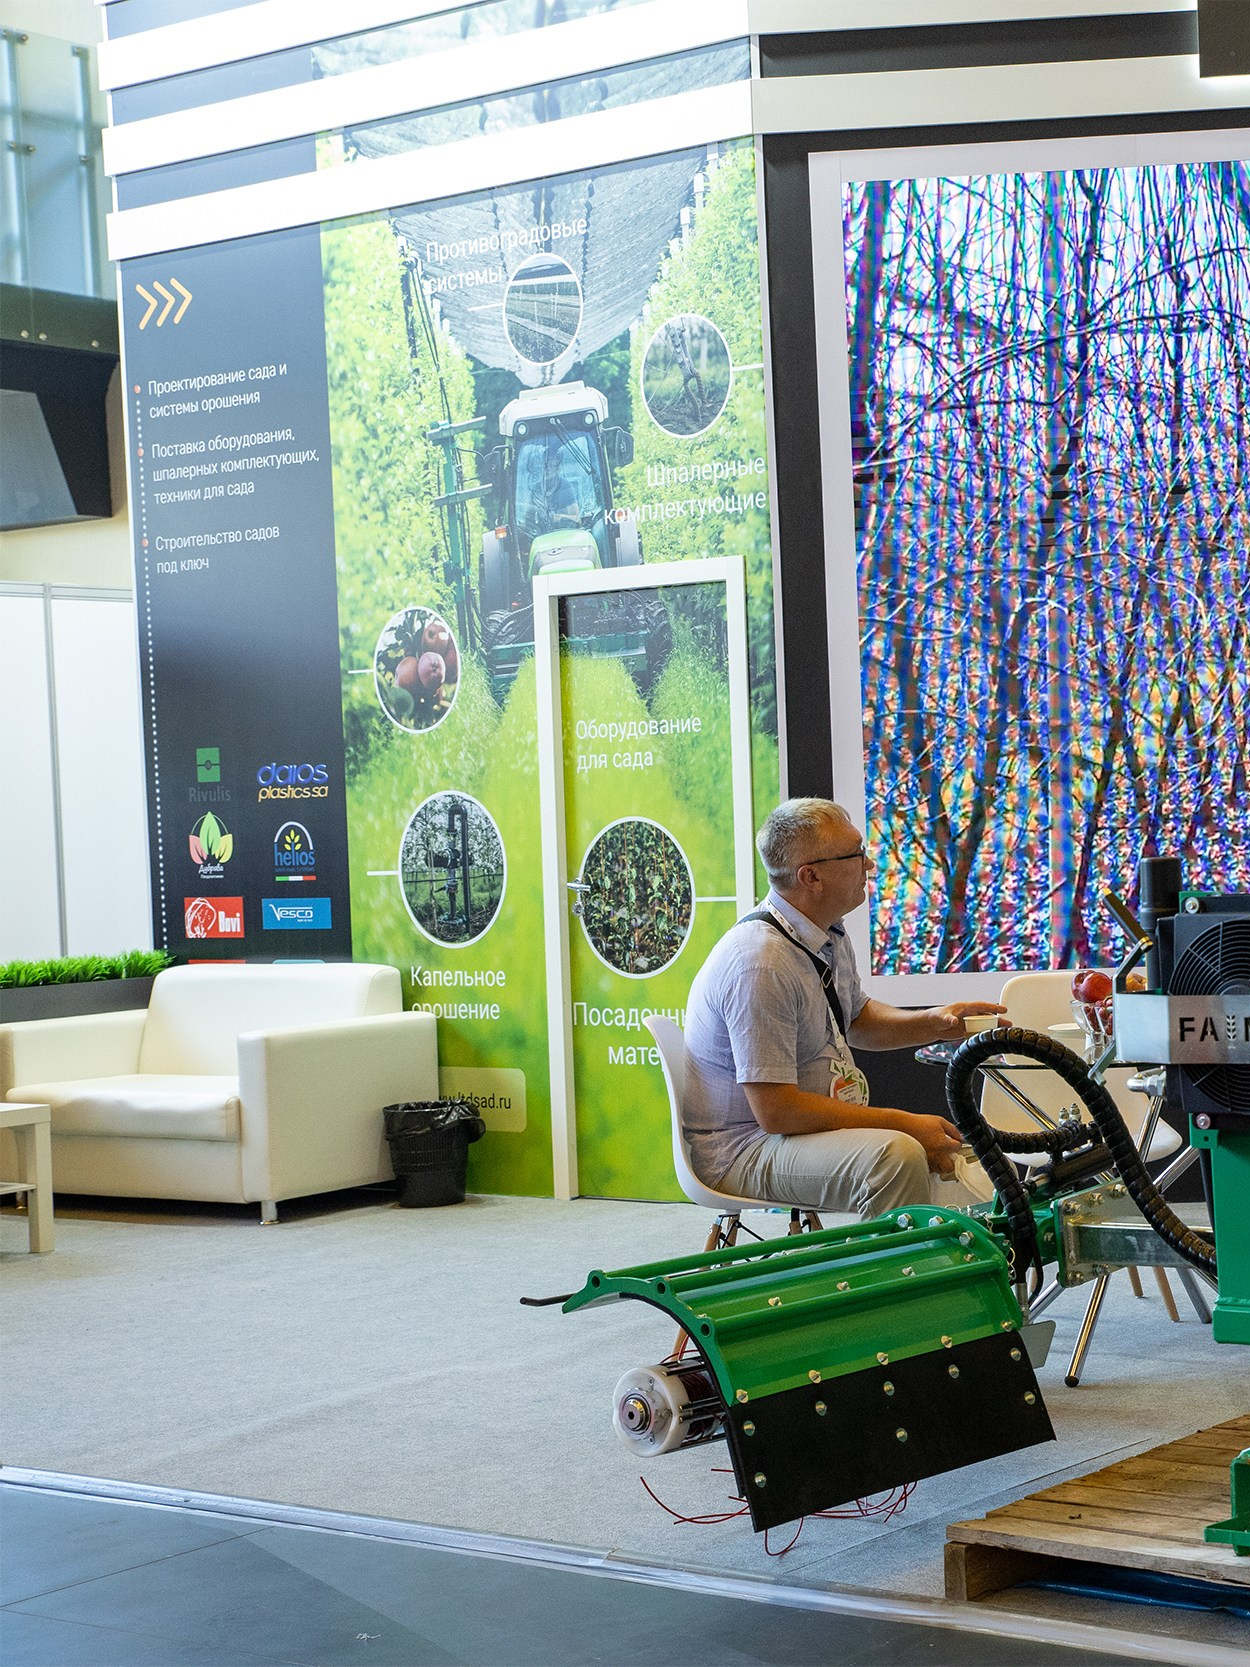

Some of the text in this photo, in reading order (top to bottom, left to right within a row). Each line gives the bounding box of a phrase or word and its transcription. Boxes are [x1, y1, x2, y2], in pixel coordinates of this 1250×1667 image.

[426, 216, 588, 263] Противоградовые
[427, 267, 503, 293] системы
[148, 363, 287, 396] Проектирование сада и
[149, 391, 261, 418] системы орошения
[152, 427, 295, 459] Поставка оборудования,
[153, 449, 320, 482] шпалерных комплектующих,
[646, 454, 765, 488] Шпалерные
[154, 480, 255, 505] техники для сада
[604, 491, 767, 526] комплектующие
[156, 526, 280, 552] Строительство садов
[157, 556, 209, 575] под ключ
[575, 715, 702, 742] Оборудование
[577, 749, 654, 773] для сада
[189, 785, 231, 802] Rivulis
[258, 785, 328, 802] plastics sa
[274, 842, 315, 866] helios
[218, 911, 240, 932] Bovi
[269, 904, 313, 921] Vesco
[410, 965, 506, 987] Капельное
[608, 1046, 661, 1066] мате
[439, 1092, 511, 1109] dsad.ru
